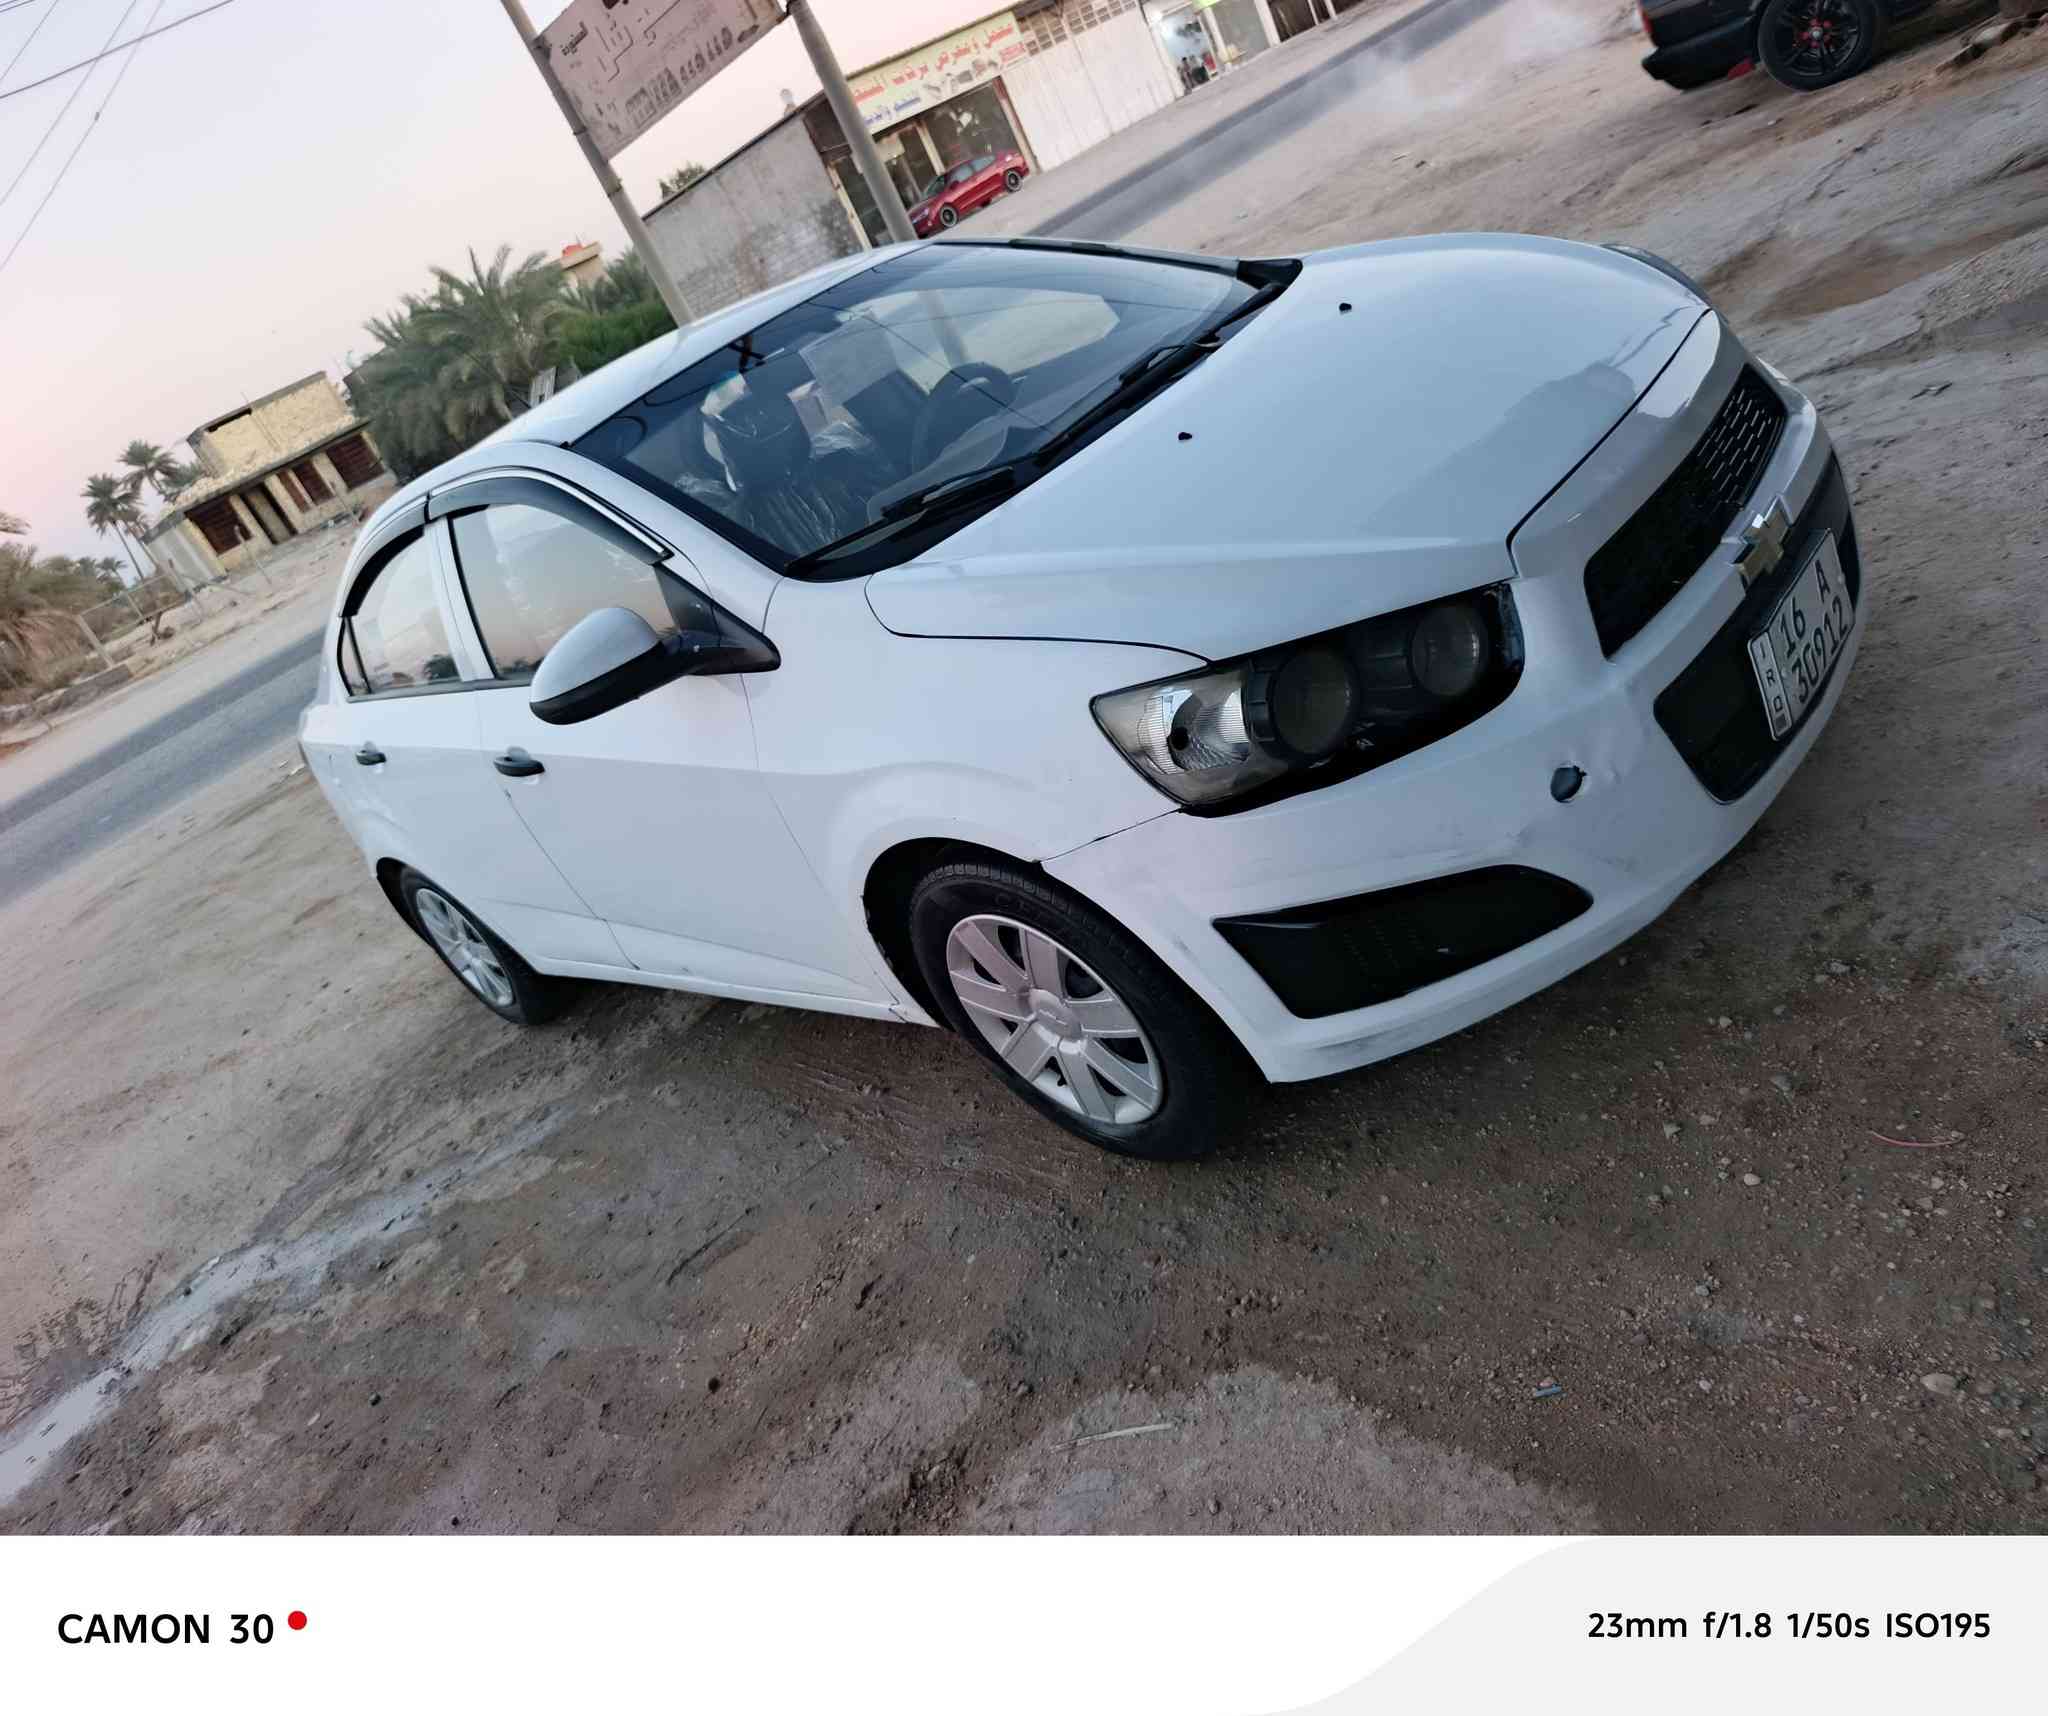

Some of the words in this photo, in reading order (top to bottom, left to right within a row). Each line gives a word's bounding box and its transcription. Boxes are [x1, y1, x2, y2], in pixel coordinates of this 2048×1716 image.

[1780, 597, 1806, 659] 16
[1814, 559, 1831, 603] A
[1791, 595, 1849, 704] 30912
